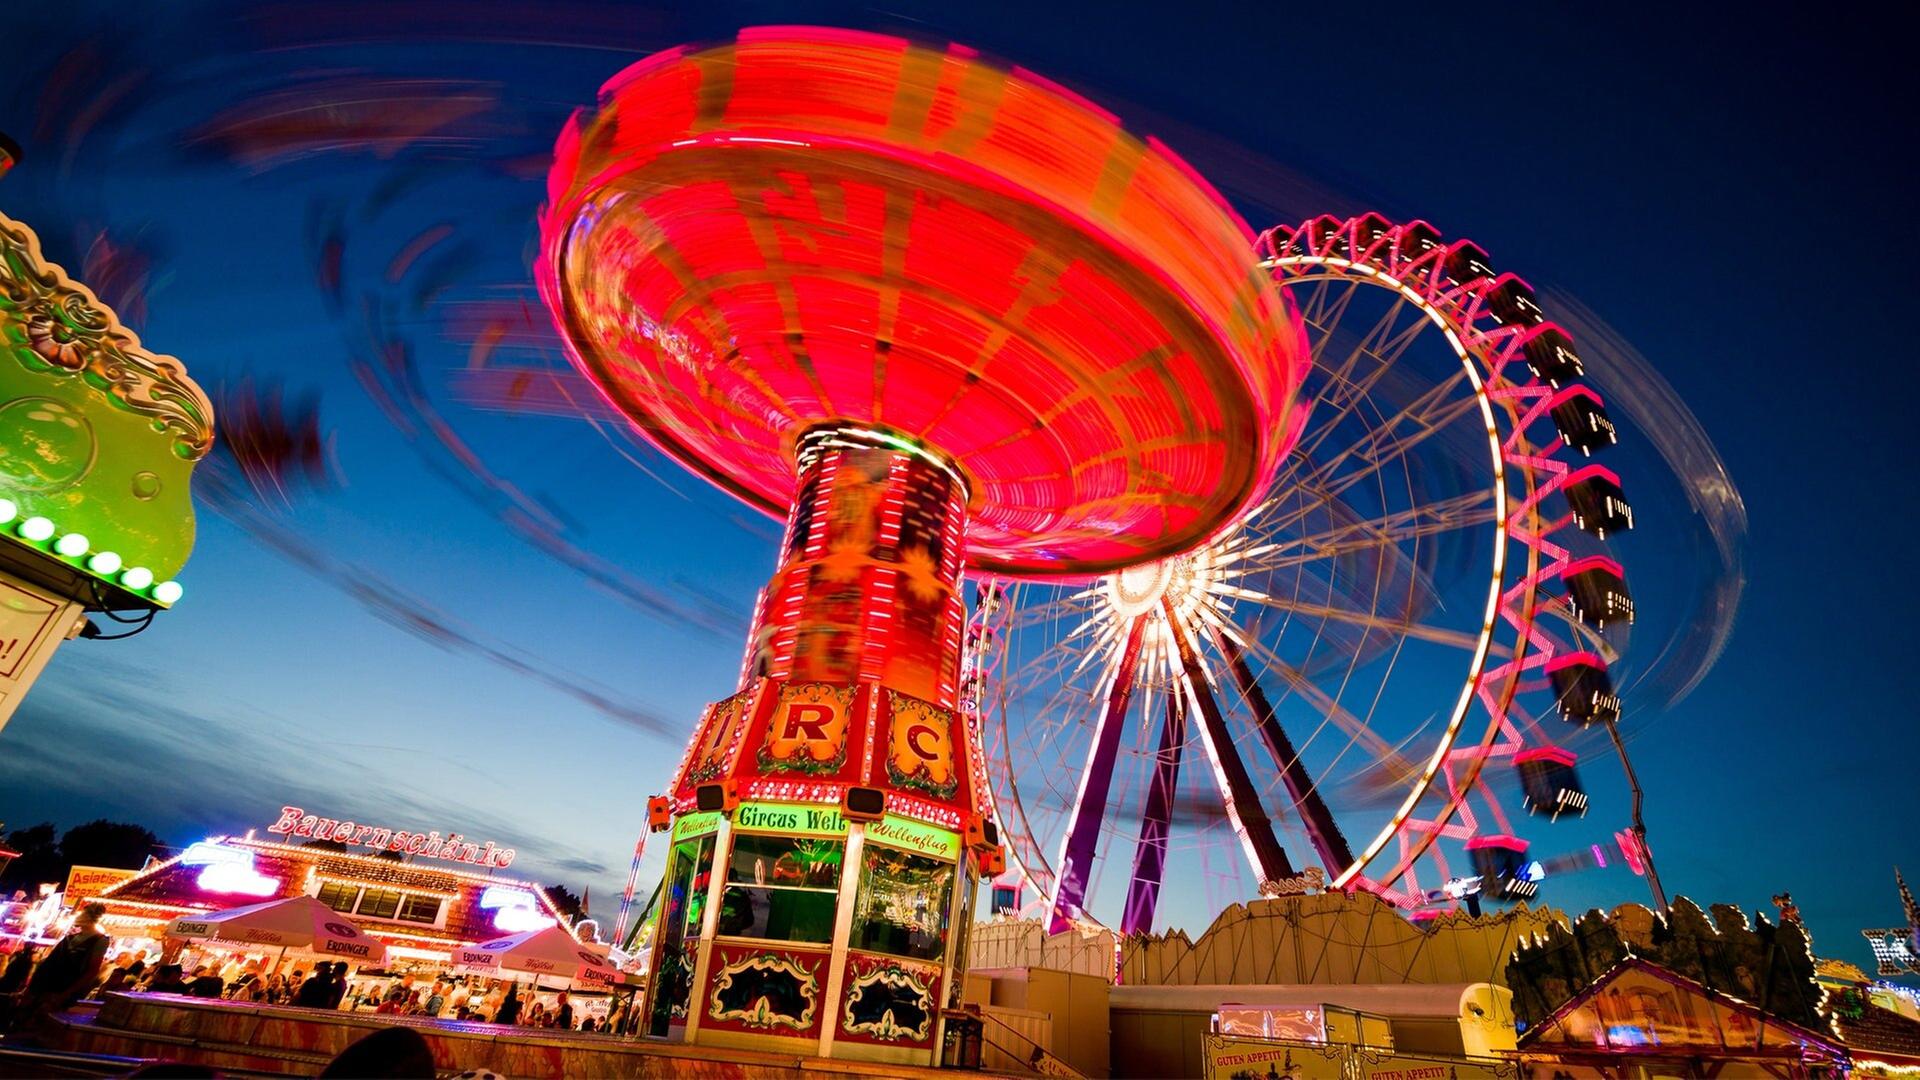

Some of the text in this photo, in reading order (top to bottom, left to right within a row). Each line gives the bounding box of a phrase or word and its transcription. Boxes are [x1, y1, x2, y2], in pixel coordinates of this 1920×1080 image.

[740, 806, 797, 829] Circus
[268, 806, 516, 868] Bauernschänke
[873, 823, 948, 855] Wellenflug
[326, 940, 370, 956] ERDINGER
[463, 952, 493, 964] ERDINGER
[1217, 1050, 1281, 1066] GUTEN APPETIT
[1406, 1067, 1445, 1080] APPETIT
